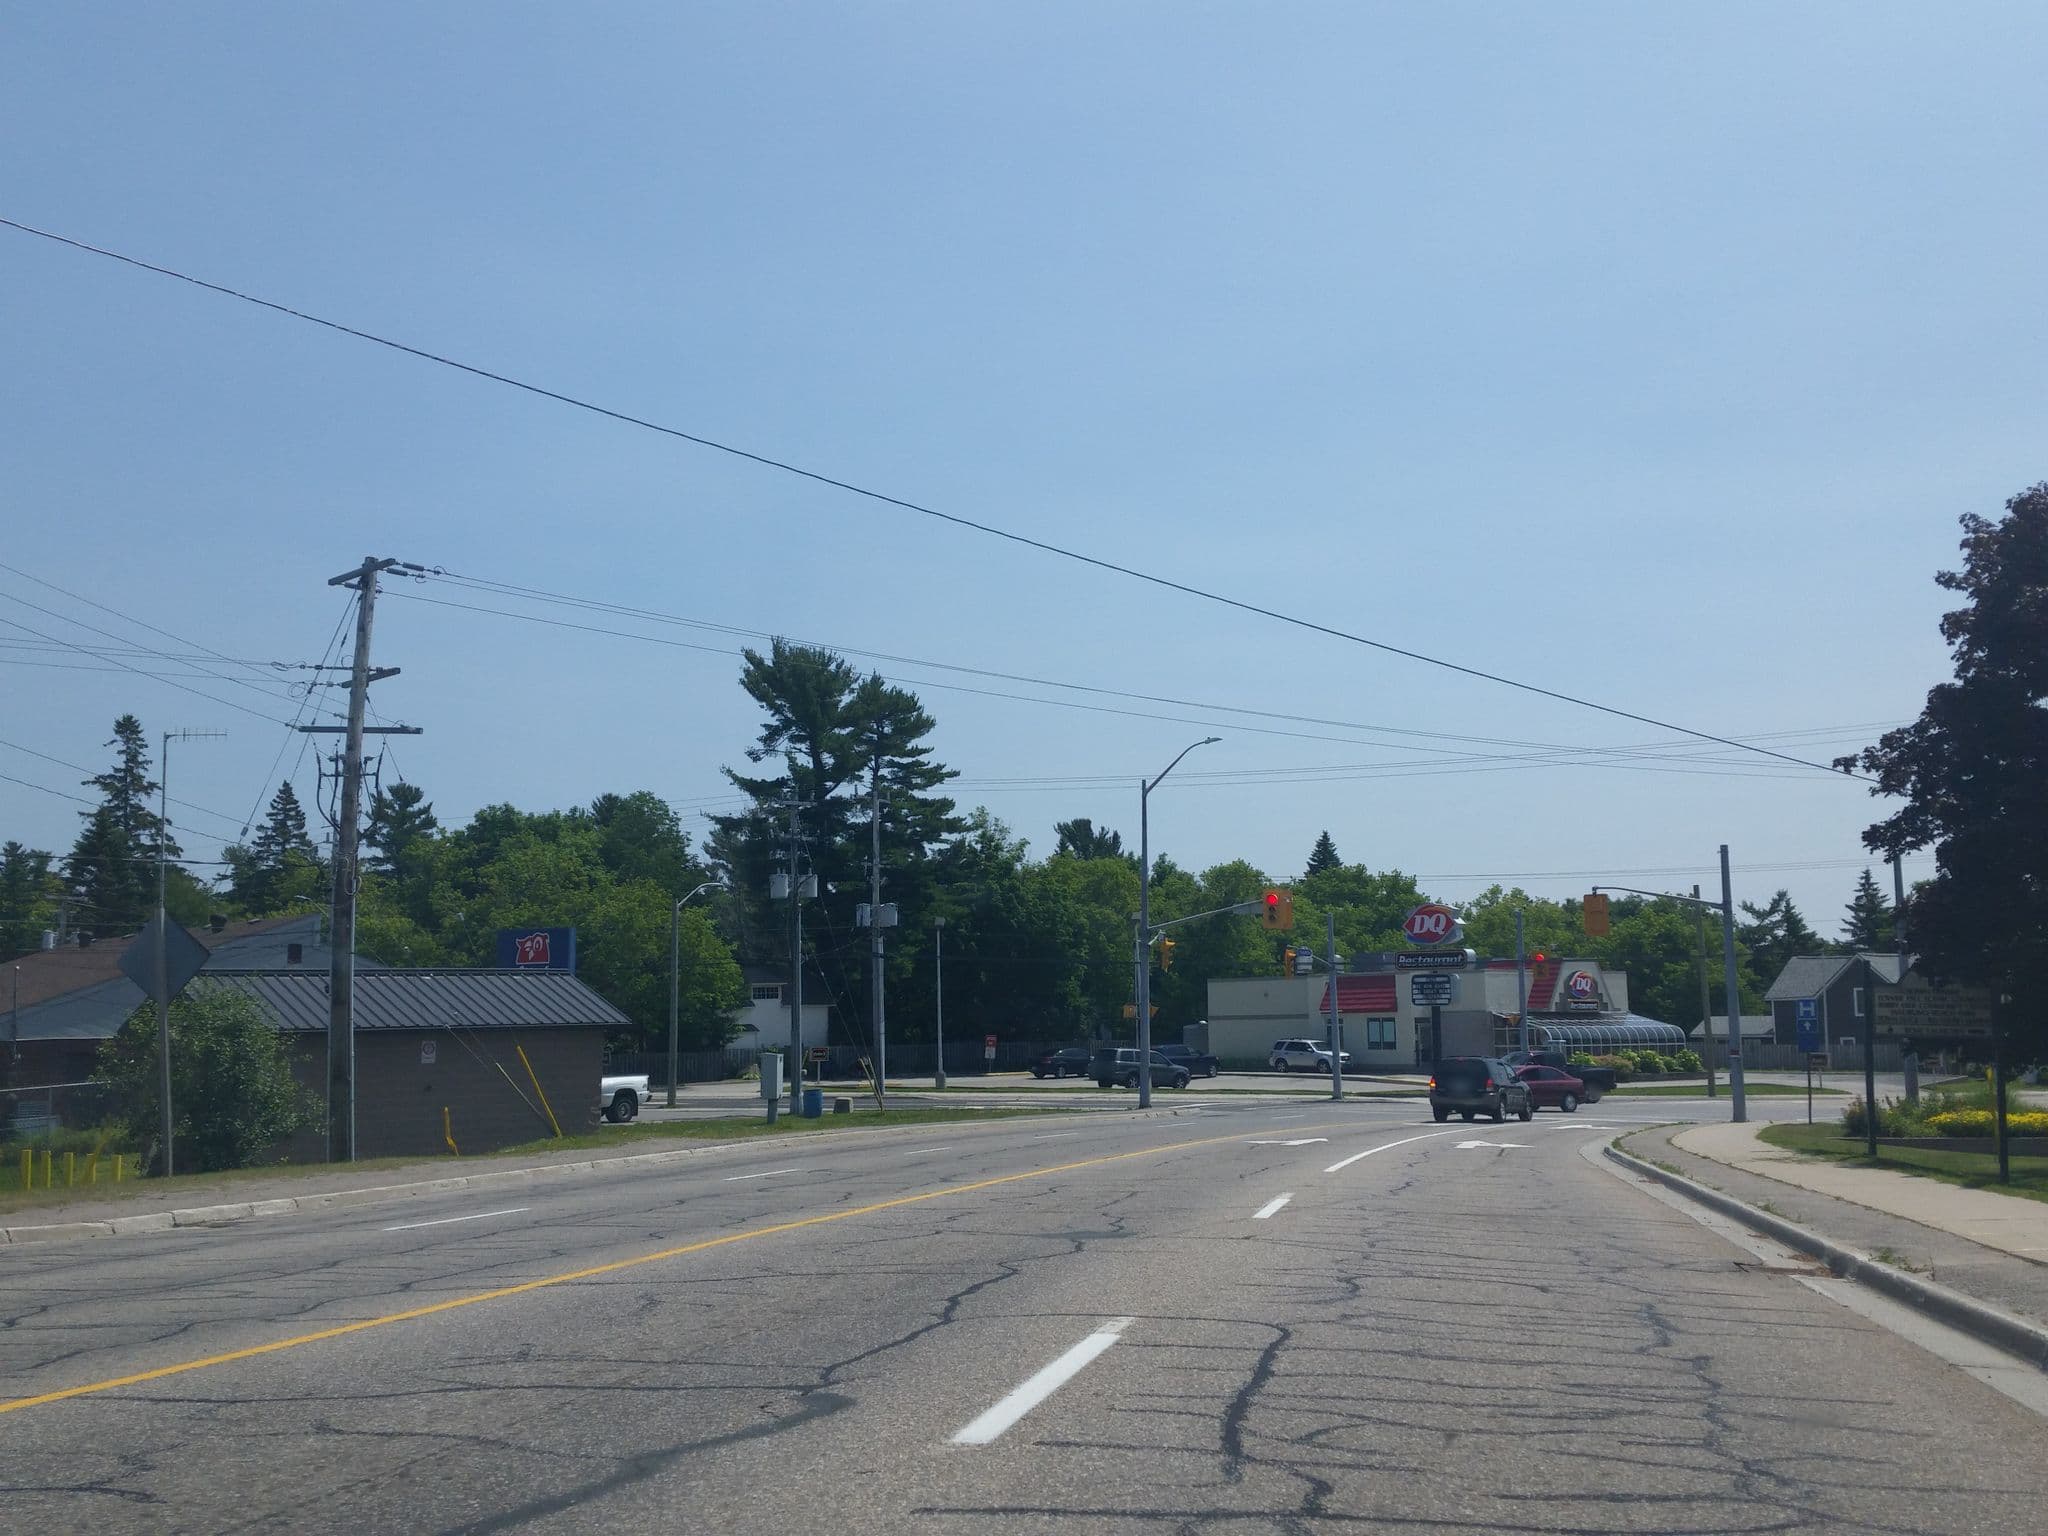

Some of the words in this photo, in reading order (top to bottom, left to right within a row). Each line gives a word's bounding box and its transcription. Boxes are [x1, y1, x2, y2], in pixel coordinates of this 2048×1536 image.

[1413, 913, 1447, 935] DQ
[1398, 954, 1463, 964] Restaurant
[1576, 977, 1592, 992] DQ
[1800, 1002, 1815, 1016] H
